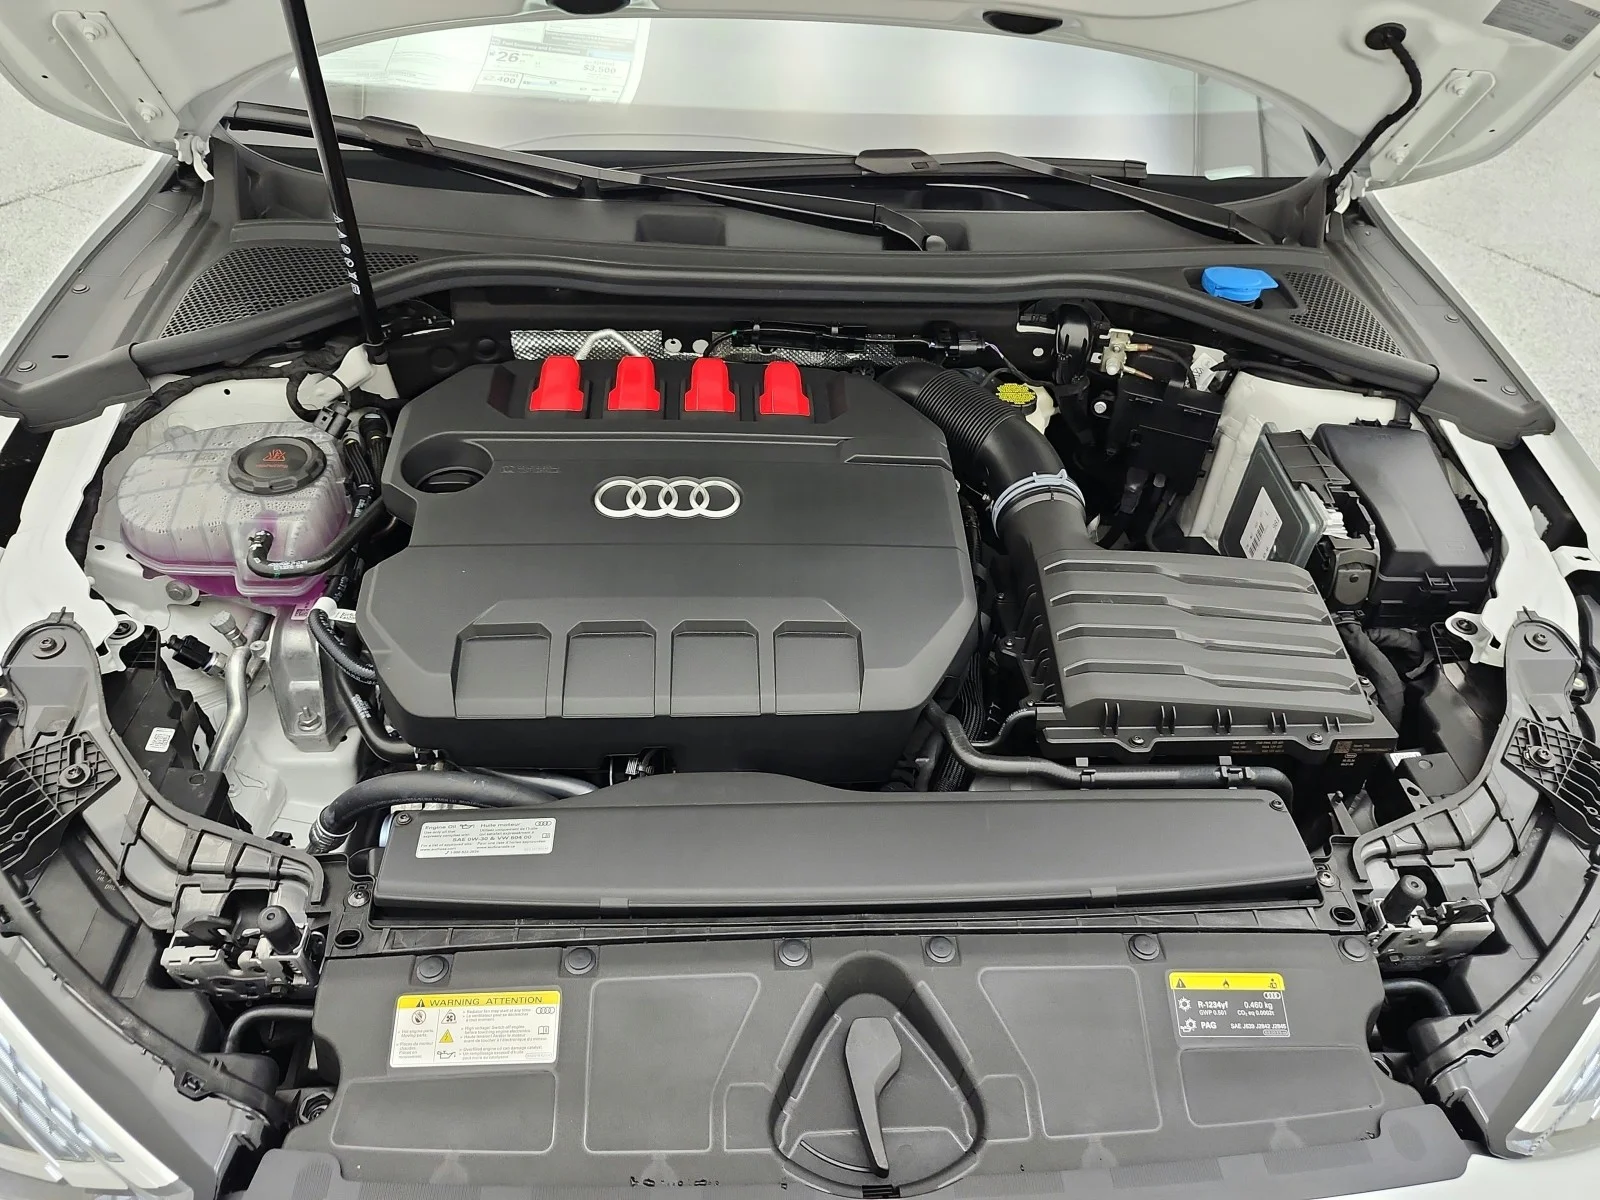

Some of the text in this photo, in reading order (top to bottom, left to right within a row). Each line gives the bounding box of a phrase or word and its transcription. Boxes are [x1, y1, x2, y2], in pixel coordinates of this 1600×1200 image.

[496, 51, 520, 63] 26
[429, 996, 543, 1007] WARNING ATTENTION
[1197, 1001, 1273, 1010] R-1234yf 0.460 kg
[1200, 1021, 1217, 1030] PAG
